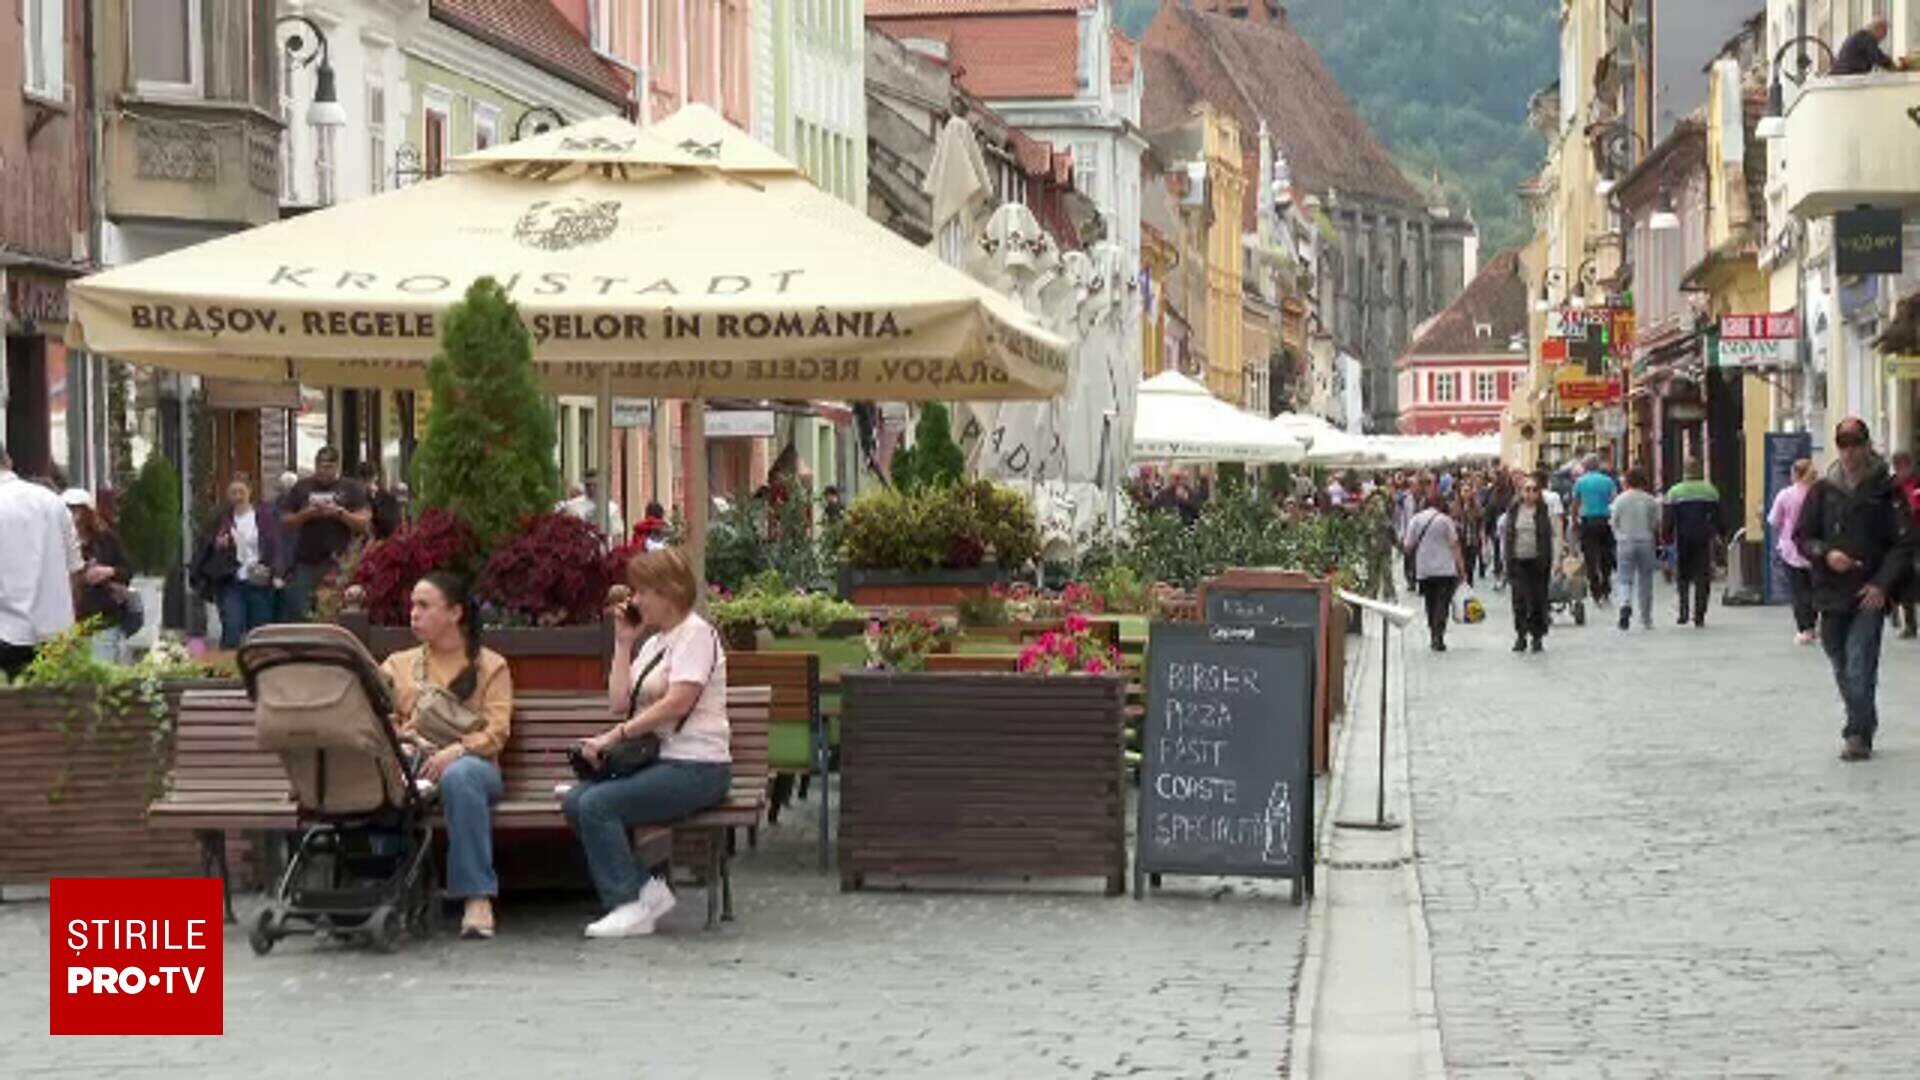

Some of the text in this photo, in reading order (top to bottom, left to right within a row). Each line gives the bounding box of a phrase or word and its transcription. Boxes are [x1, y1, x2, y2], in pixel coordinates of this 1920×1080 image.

[267, 265, 804, 295] KROSTADT
[131, 304, 912, 345] BRAȘOV. REGELE ȘELOR ÎN ROMÂNIA.
